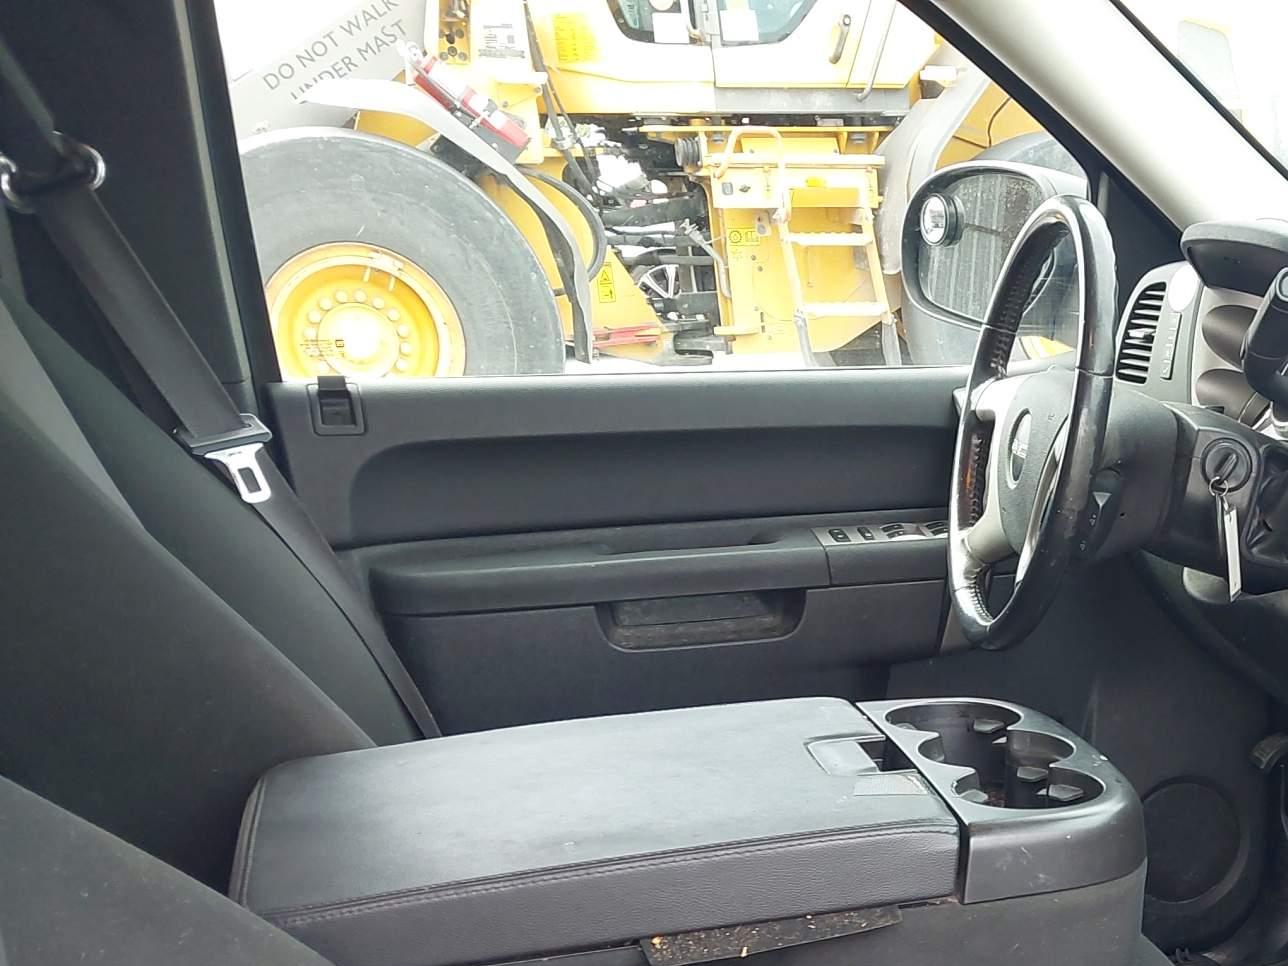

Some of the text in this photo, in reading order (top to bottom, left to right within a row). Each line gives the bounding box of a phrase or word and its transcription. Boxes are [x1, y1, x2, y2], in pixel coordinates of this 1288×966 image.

[262, 0, 399, 90] DO NOT WALK
[356, 19, 407, 61] MAST
